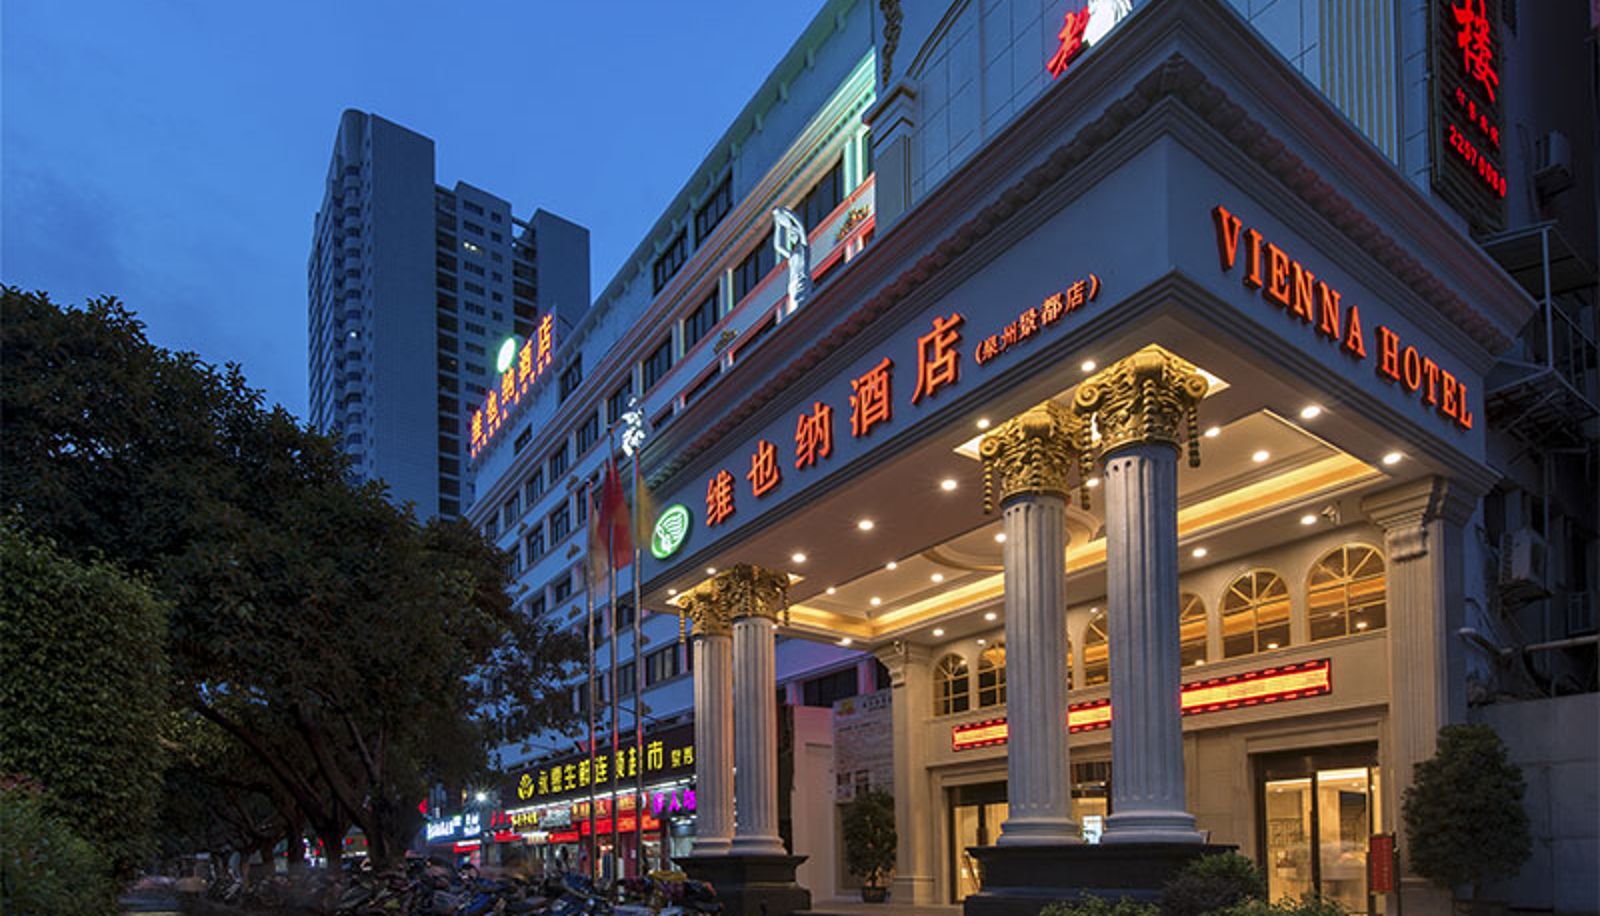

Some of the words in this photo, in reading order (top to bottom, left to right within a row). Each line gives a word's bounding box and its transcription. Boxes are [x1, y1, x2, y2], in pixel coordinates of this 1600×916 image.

[705, 312, 966, 527] 维也纳酒店
[1212, 204, 1367, 359] VIENNA
[1375, 325, 1473, 431] HOTEL
